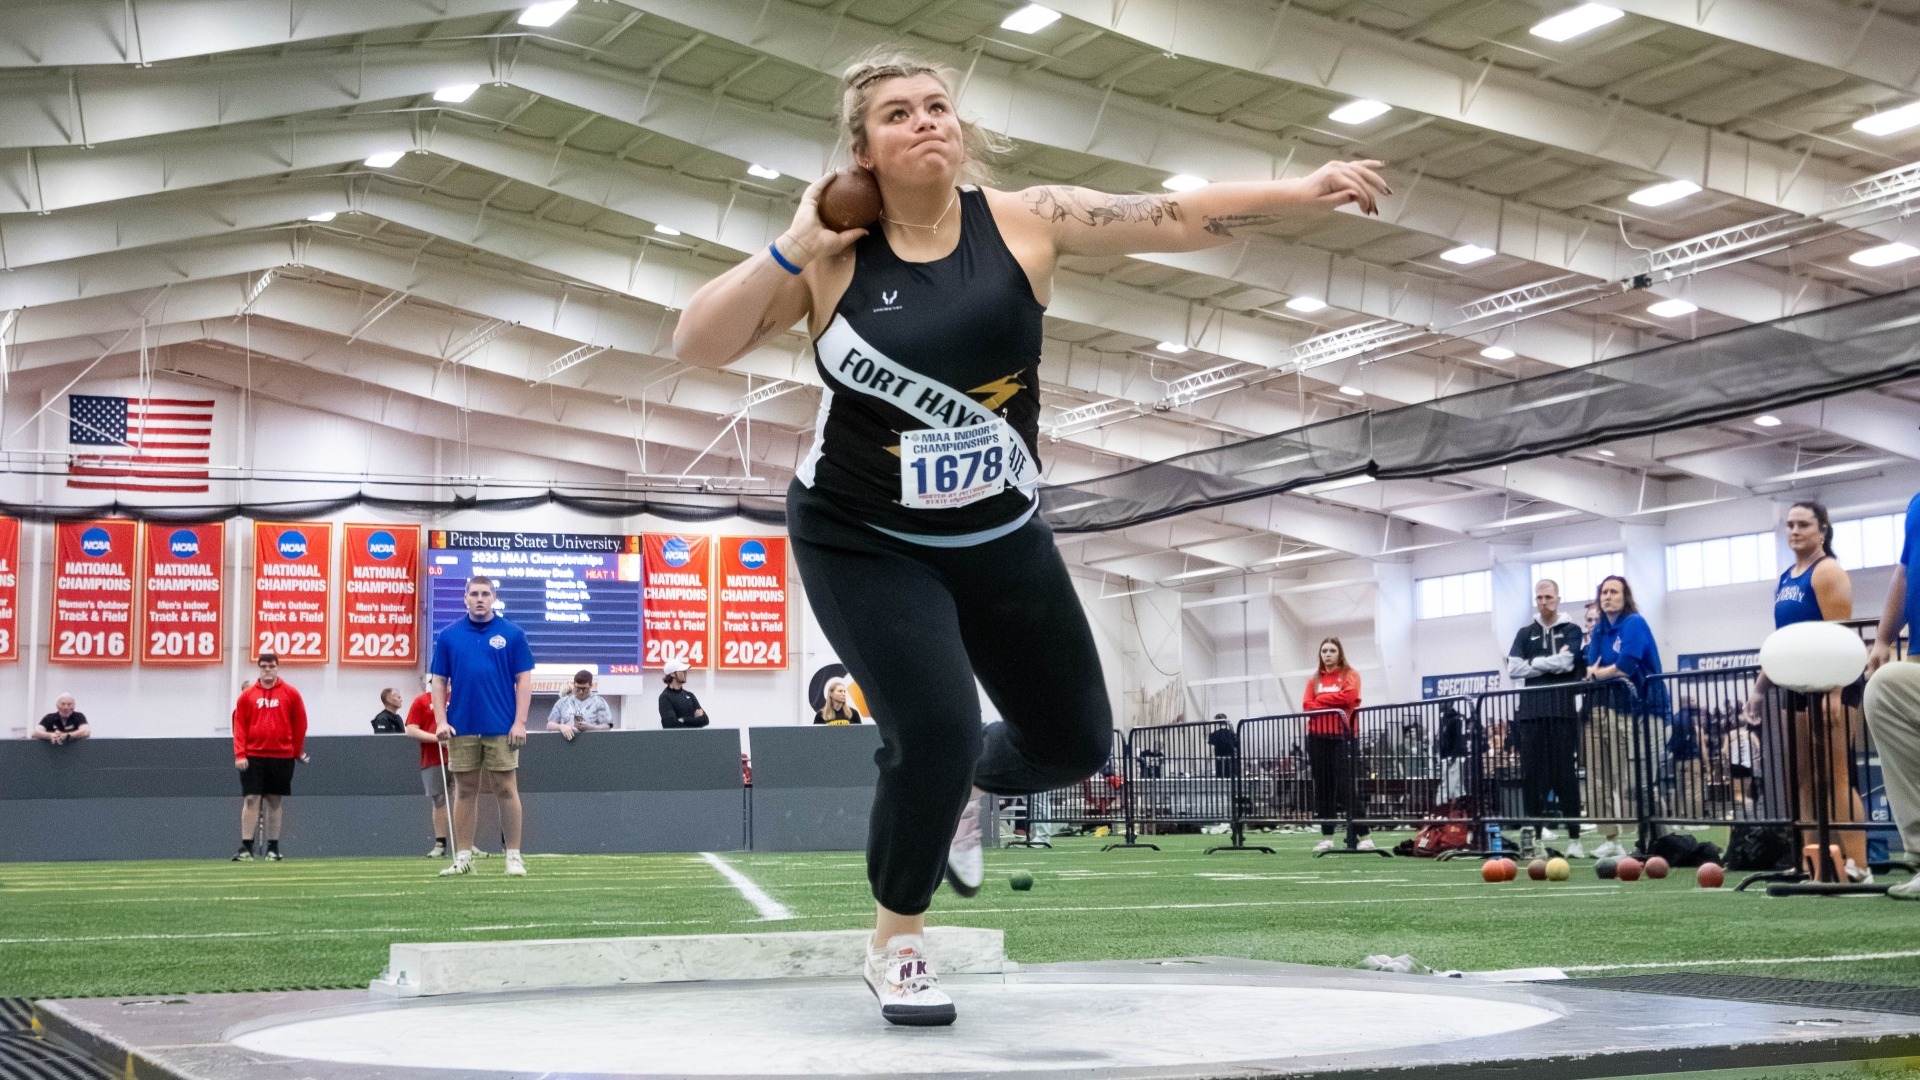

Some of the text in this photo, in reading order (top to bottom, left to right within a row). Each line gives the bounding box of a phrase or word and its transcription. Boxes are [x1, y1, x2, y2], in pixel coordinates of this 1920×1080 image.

[839, 347, 917, 398] FORT
[921, 426, 990, 443] MIAA INDOOR
[913, 434, 999, 454] CHAMPIONSHIPS
[910, 446, 1003, 494] 1678
[83, 541, 110, 550] NCAA
[172, 542, 198, 552] NCAA
[450, 532, 511, 550] Pittsburg
[514, 533, 549, 549] State
[281, 543, 306, 553] NCAA
[370, 544, 395, 553] NCAA
[472, 551, 498, 563] 2026
[500, 552, 528, 563] MIAA
[665, 550, 689, 560] NCAA
[742, 553, 766, 563] NCAA
[65, 562, 125, 576] NATIONAL
[155, 564, 213, 576] NATIONAL
[263, 564, 321, 577] NATIONAL
[353, 567, 409, 579] NATIONAL
[585, 570, 608, 579] HEAT
[58, 578, 131, 591] CHAMPIONS
[148, 579, 219, 591] CHAMPIONS
[257, 579, 326, 592] CHAMPIONS
[649, 573, 702, 586] NATIONAL
[727, 575, 779, 588] NATIONAL
[347, 581, 414, 594] CHAMPIONS
[644, 587, 707, 601] CHAMPIONS
[721, 590, 784, 602] CHAMPIONS
[58, 599, 129, 610] Women's Outdoor
[157, 601, 209, 610] Men's Indoor
[263, 601, 320, 610] Men's Outdoor
[356, 603, 405, 612] Men's Indoor
[59, 610, 128, 622] Track & Field
[150, 611, 217, 622] Track & Field
[258, 611, 324, 622] Track & Field
[349, 613, 412, 624] Track & Field
[644, 609, 706, 619] Women's Outdoor
[726, 611, 780, 620] Men's Outdoor
[645, 619, 705, 631] Track & Field
[723, 621, 783, 632] Track & Field
[59, 631, 125, 656] 2016
[150, 632, 215, 656] 2018
[259, 631, 321, 655] 2022
[349, 633, 410, 657] 2023
[646, 640, 703, 663] 2024
[725, 641, 782, 664] 2024
[1437, 676, 1487, 696] SPECTATOR
